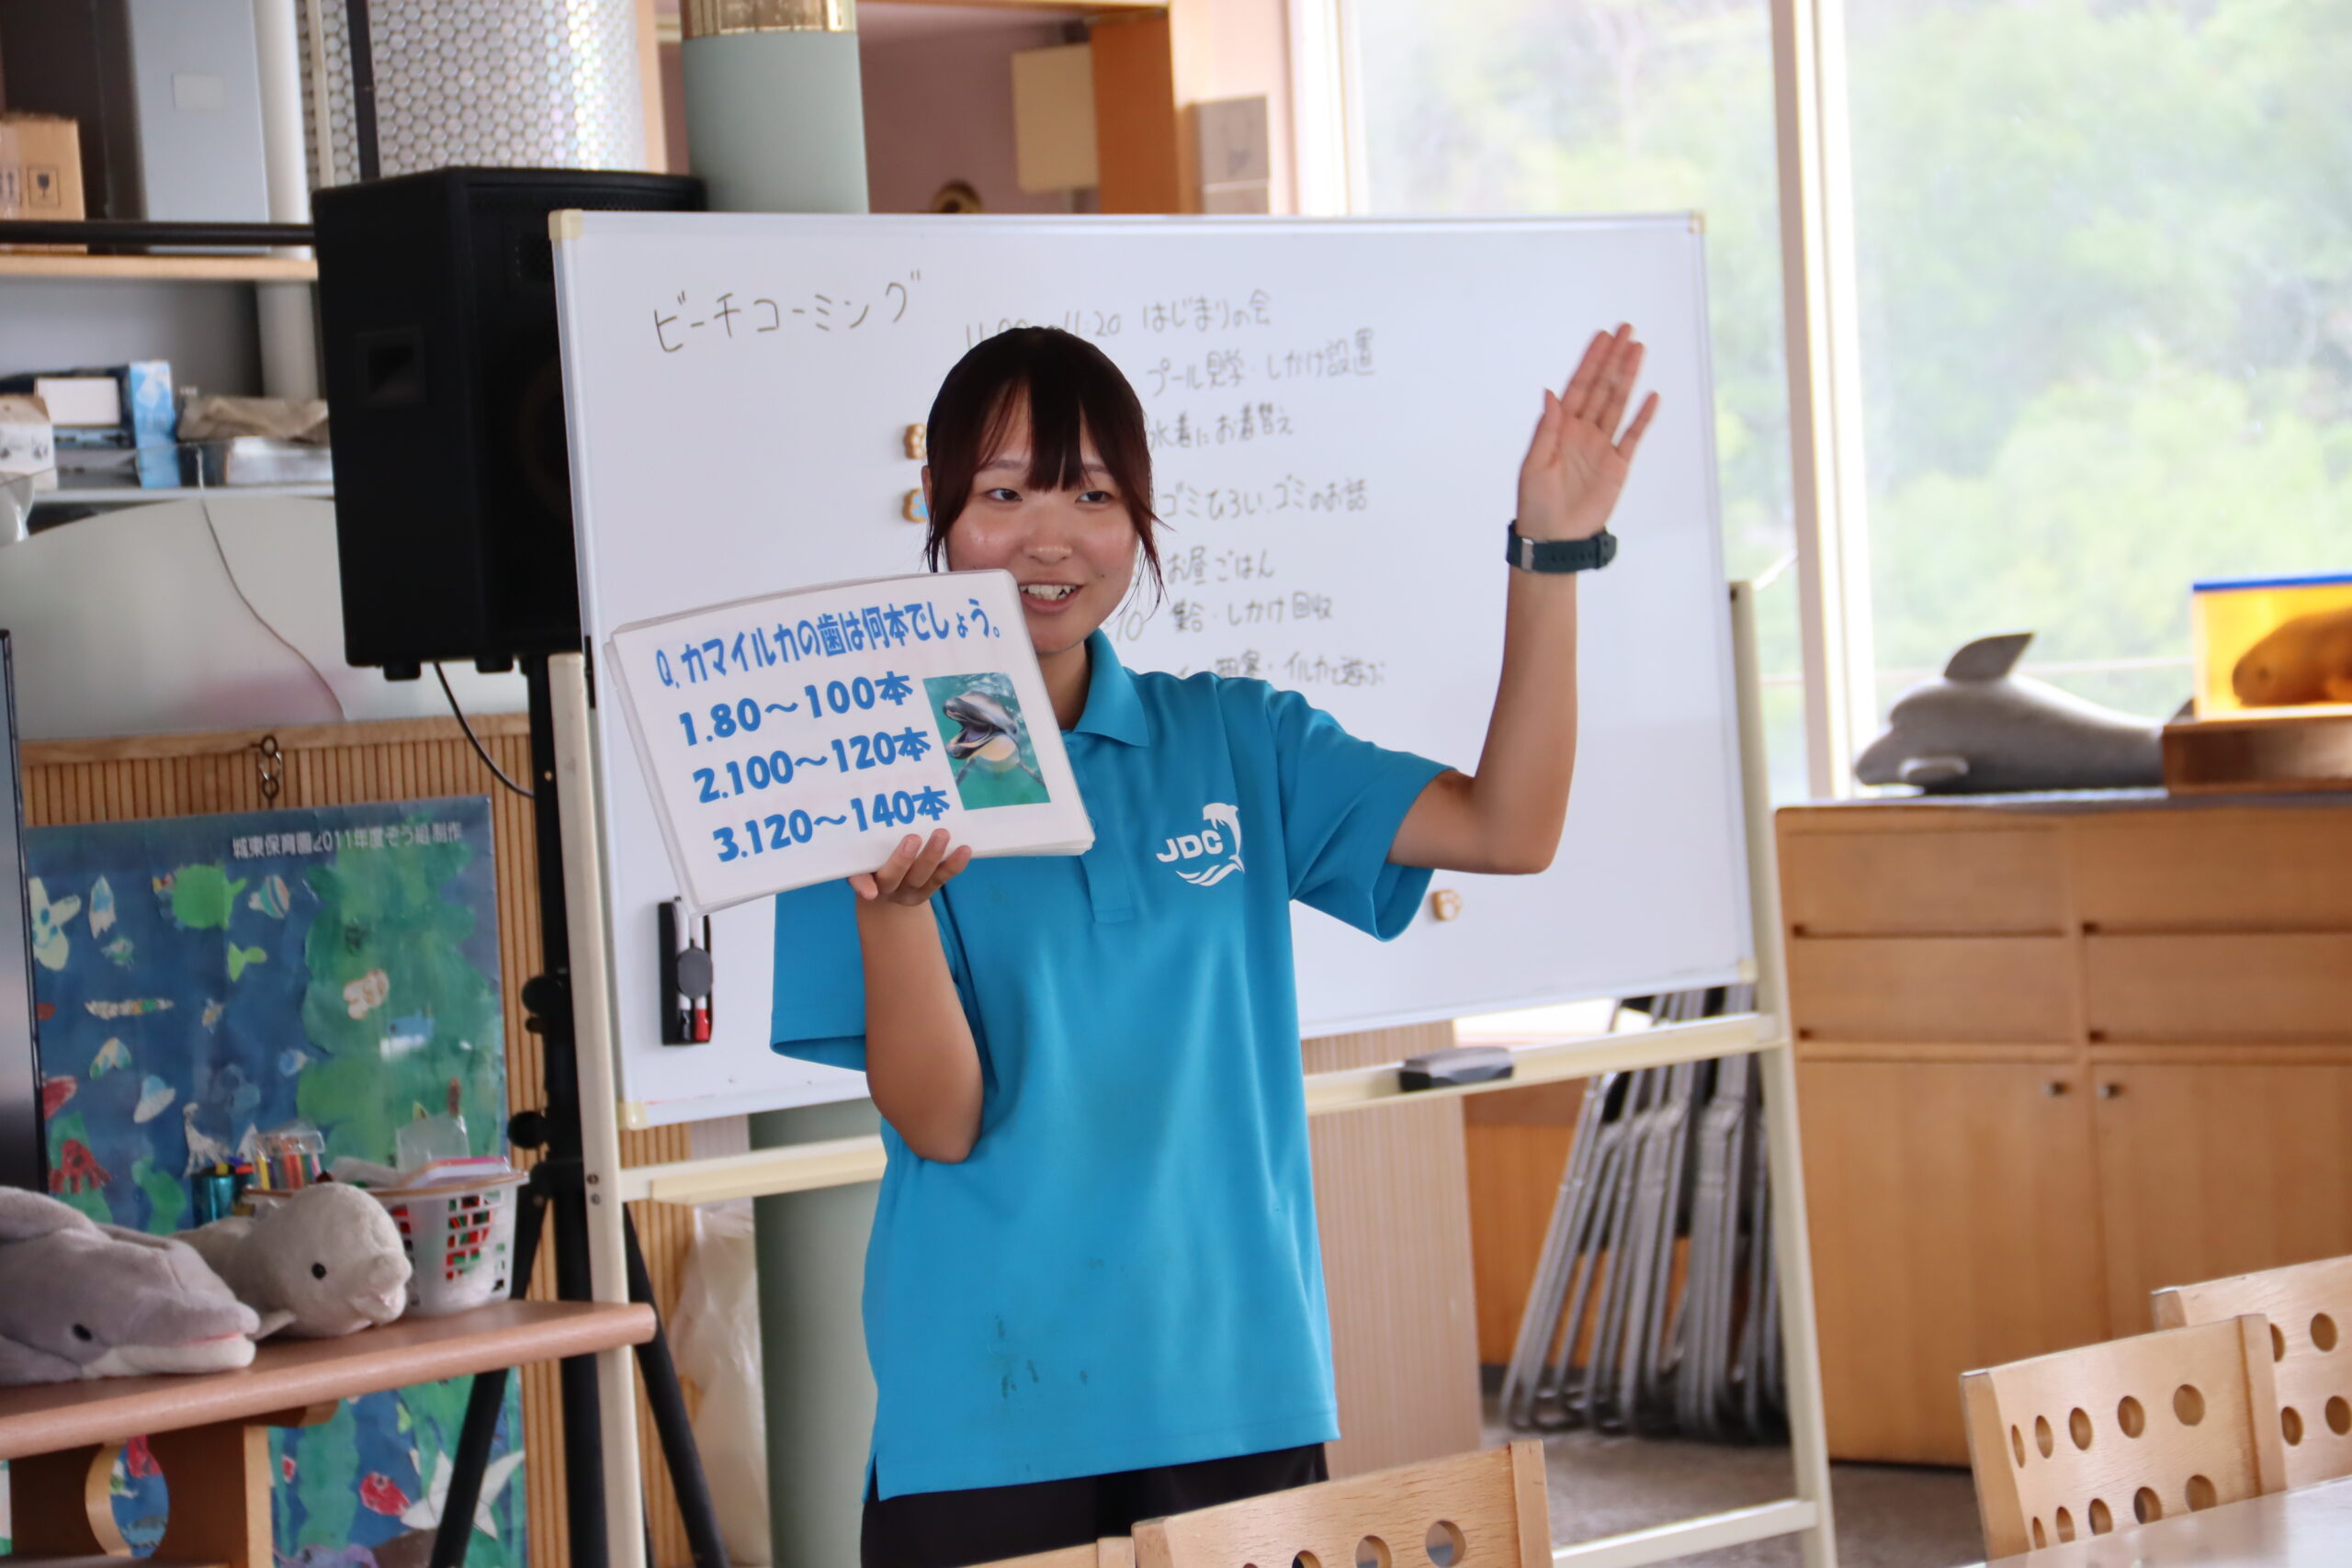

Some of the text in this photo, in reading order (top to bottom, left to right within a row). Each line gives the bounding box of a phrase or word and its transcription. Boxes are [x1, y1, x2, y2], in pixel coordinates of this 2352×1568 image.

[655, 270, 920, 352] ビーチコーミング
[1143, 289, 1272, 332] はじまりの会
[1167, 546, 1275, 586] お昼ごはん
[1156, 829, 1224, 863] JDC
